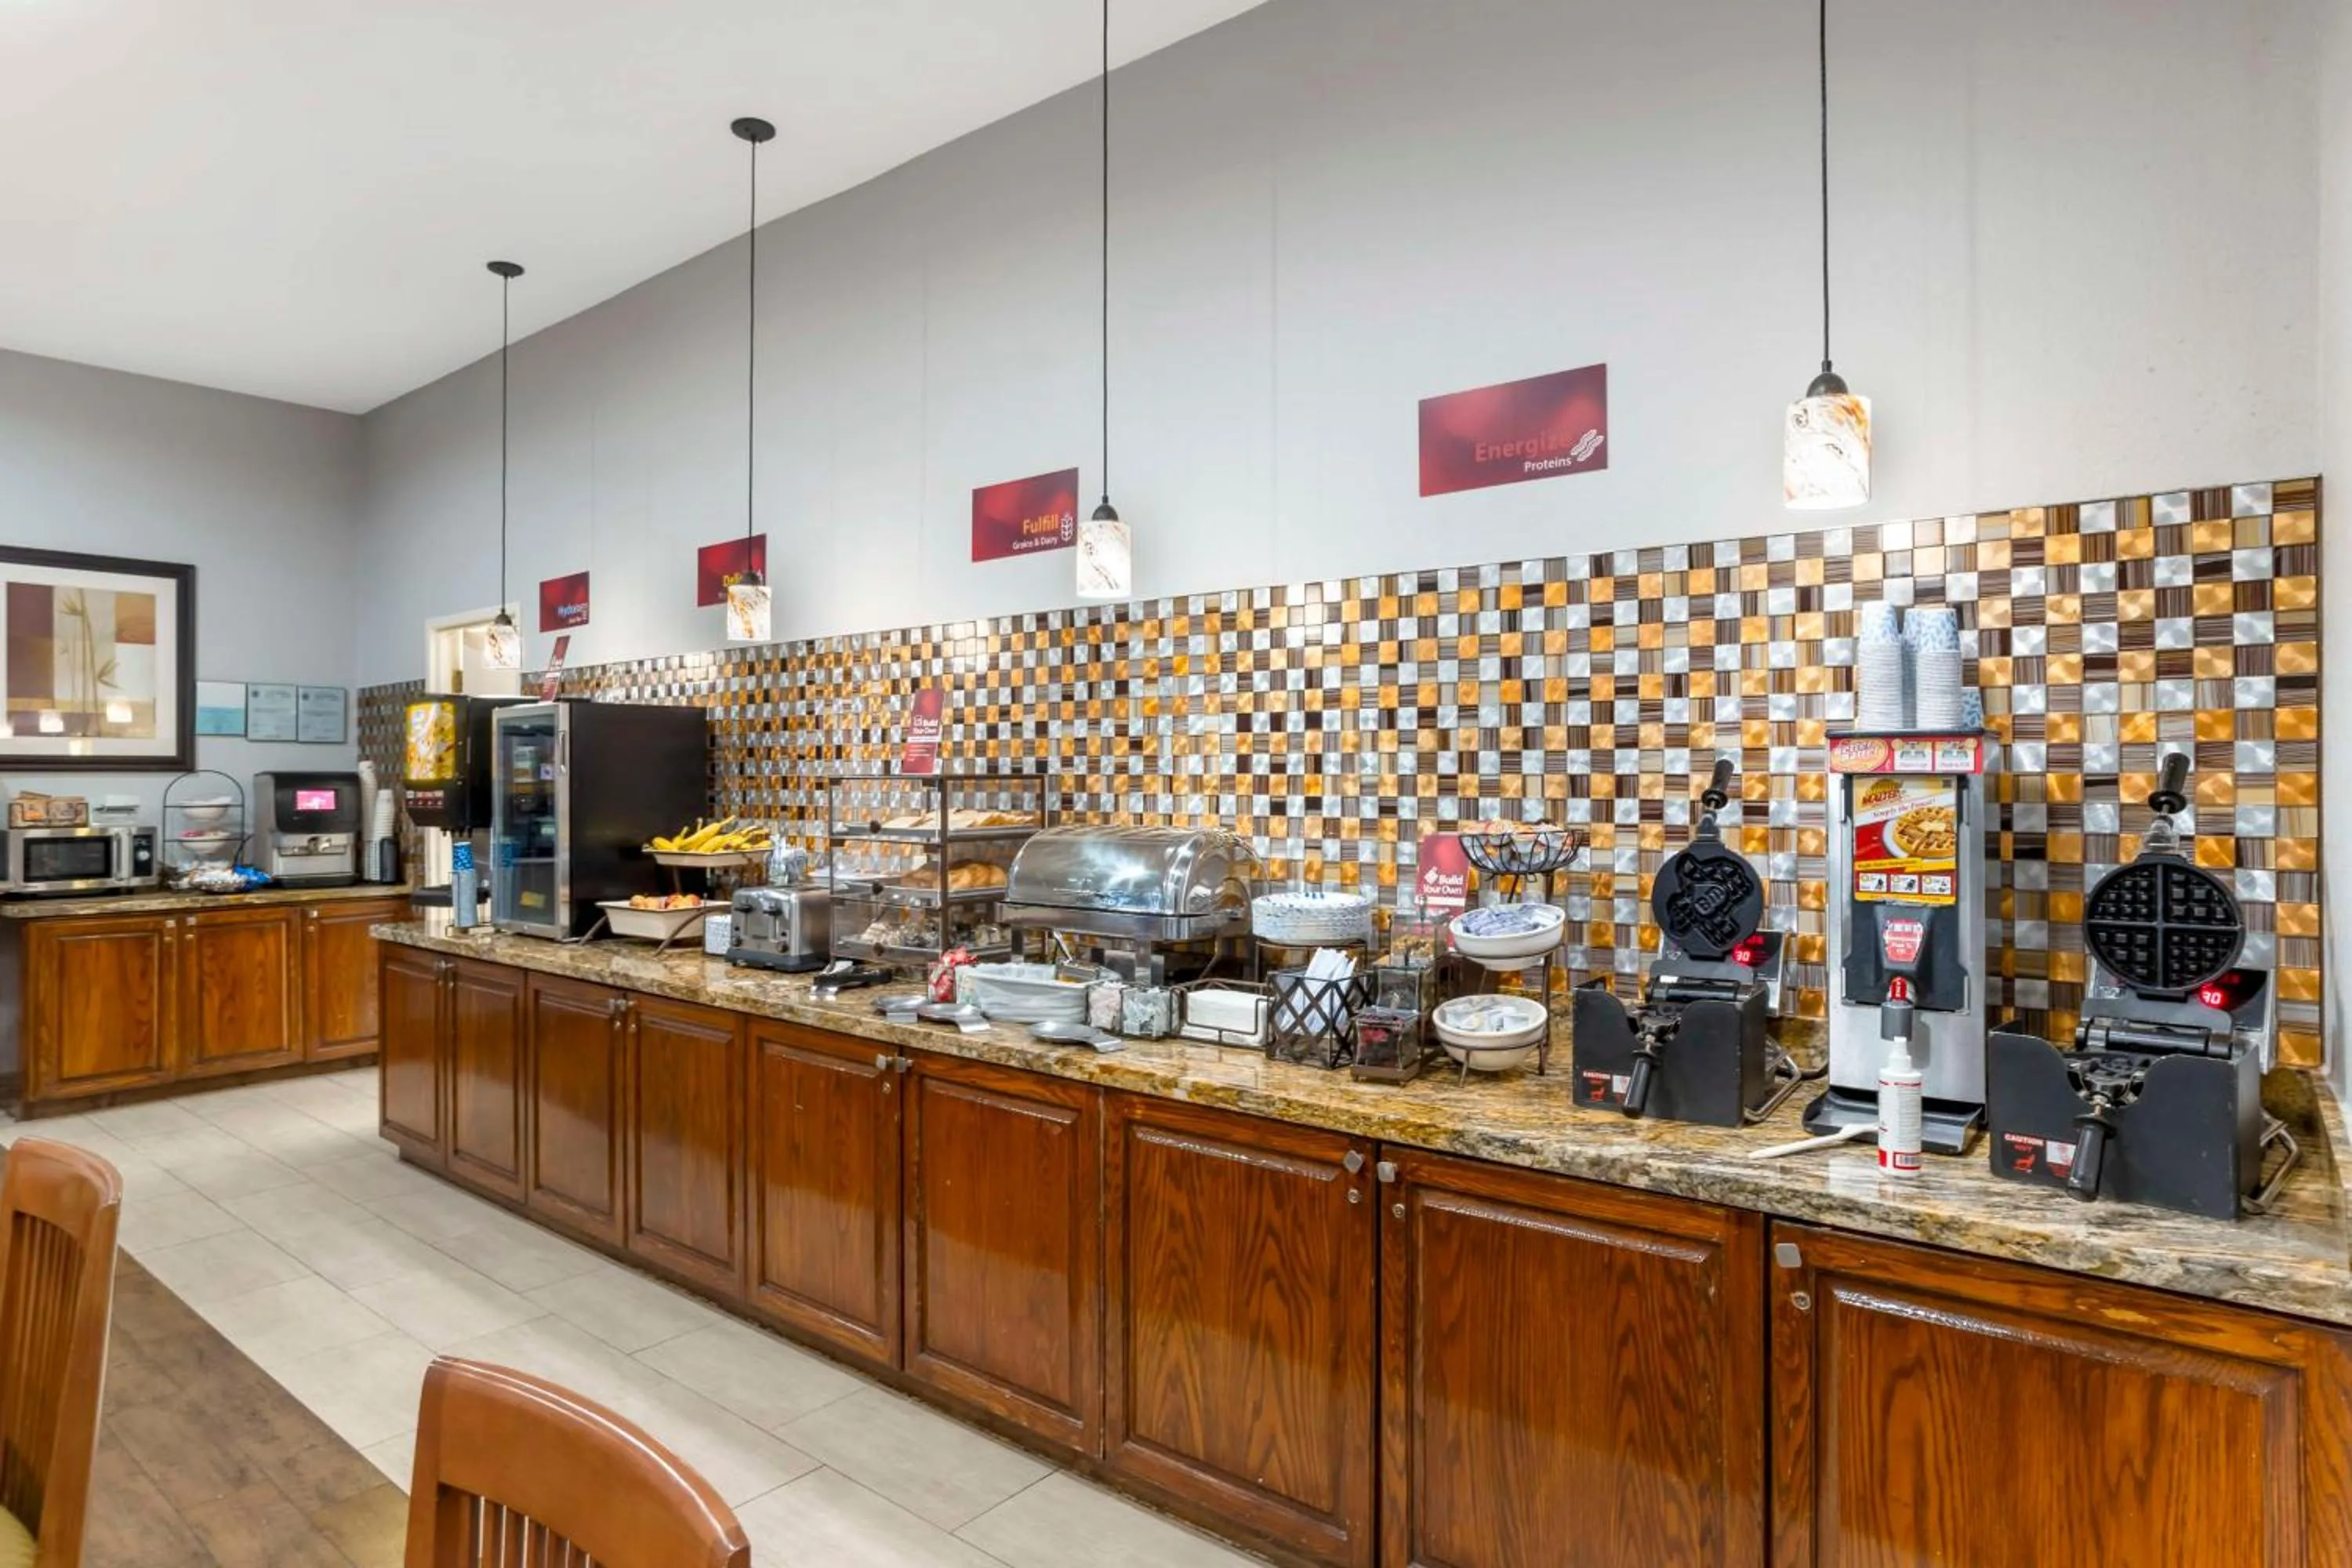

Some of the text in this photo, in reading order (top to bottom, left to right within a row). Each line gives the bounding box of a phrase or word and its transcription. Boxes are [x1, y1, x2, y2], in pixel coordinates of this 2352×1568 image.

[1475, 431, 1570, 463] Energize
[1523, 456, 1572, 473] Proteins
[1022, 514, 1059, 535] Fulfill
[1438, 874, 1464, 885] Build
[1423, 884, 1462, 895] Your Own
